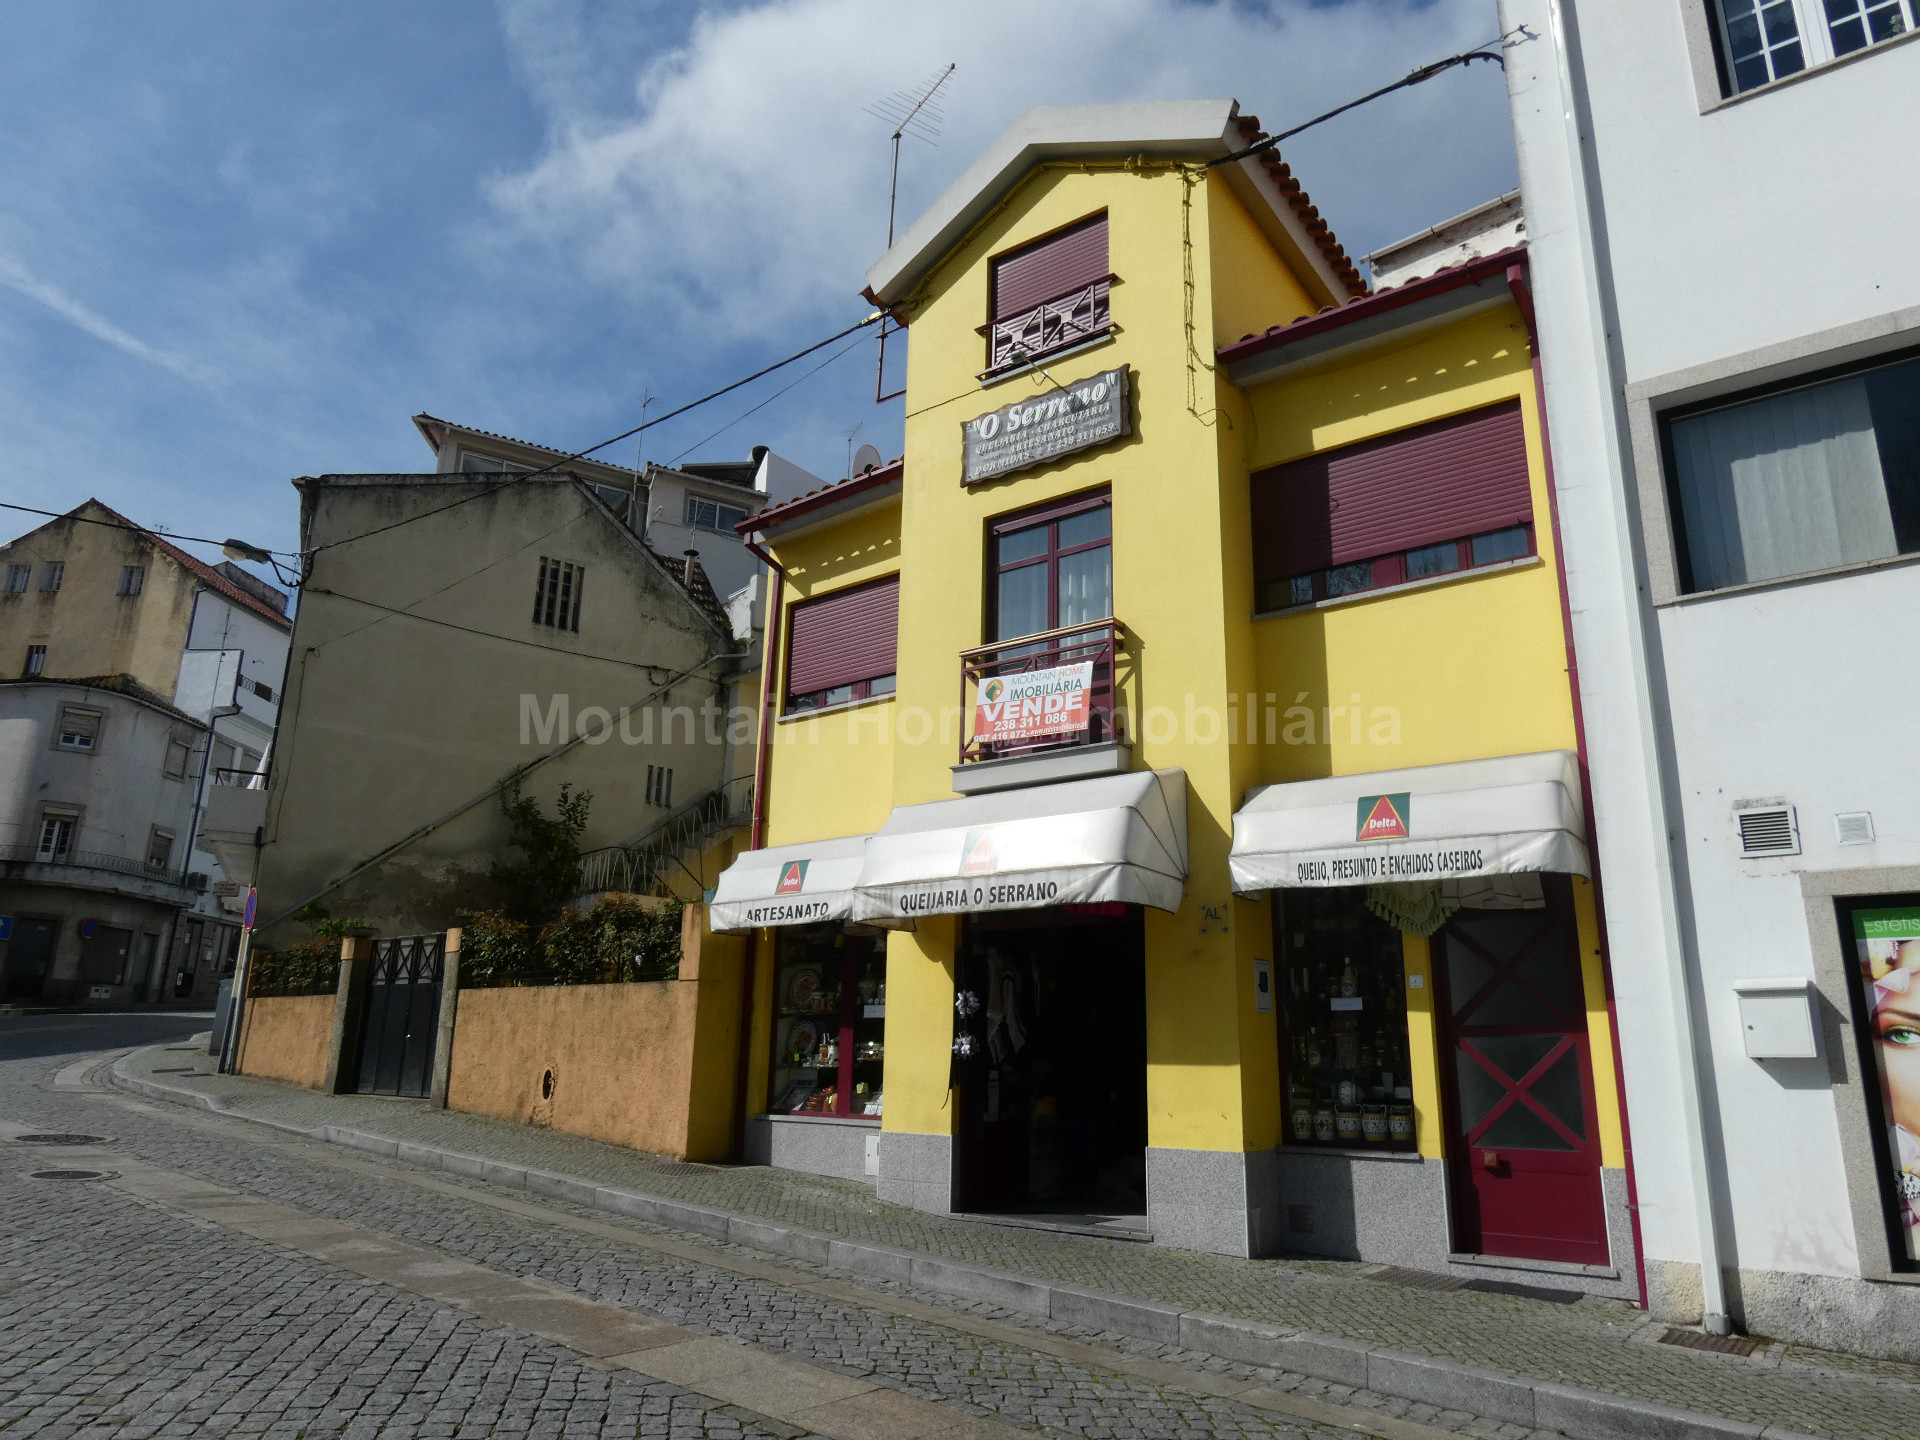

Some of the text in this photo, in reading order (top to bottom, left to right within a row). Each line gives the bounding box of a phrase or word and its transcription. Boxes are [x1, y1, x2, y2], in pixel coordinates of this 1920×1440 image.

[975, 402, 1110, 455] QUEIJARIA CHARCUTARIA
[1009, 426, 1074, 455] ARTESANATO
[974, 451, 1030, 475] DORMIDAS
[1056, 435, 1074, 449] 238
[1011, 666, 1084, 686] MOUNTAIN HOME
[1010, 678, 1082, 700] IMOBILIÁRIA
[983, 690, 1084, 722] VENDE
[994, 711, 1068, 732] 238 311 086
[973, 733, 990, 743] 967
[992, 731, 1008, 741] 416
[1010, 729, 1027, 739] 872
[1369, 817, 1397, 829] Delta
[1297, 850, 1483, 885] QUEIJO, PRESUNTO E ENCHIDOS CASEIROS
[783, 877, 799, 886] Delta
[900, 881, 1058, 914] QUEIJARIA O SERRANO
[744, 902, 829, 922] ARTESANATO
[1204, 907, 1222, 920] AL
